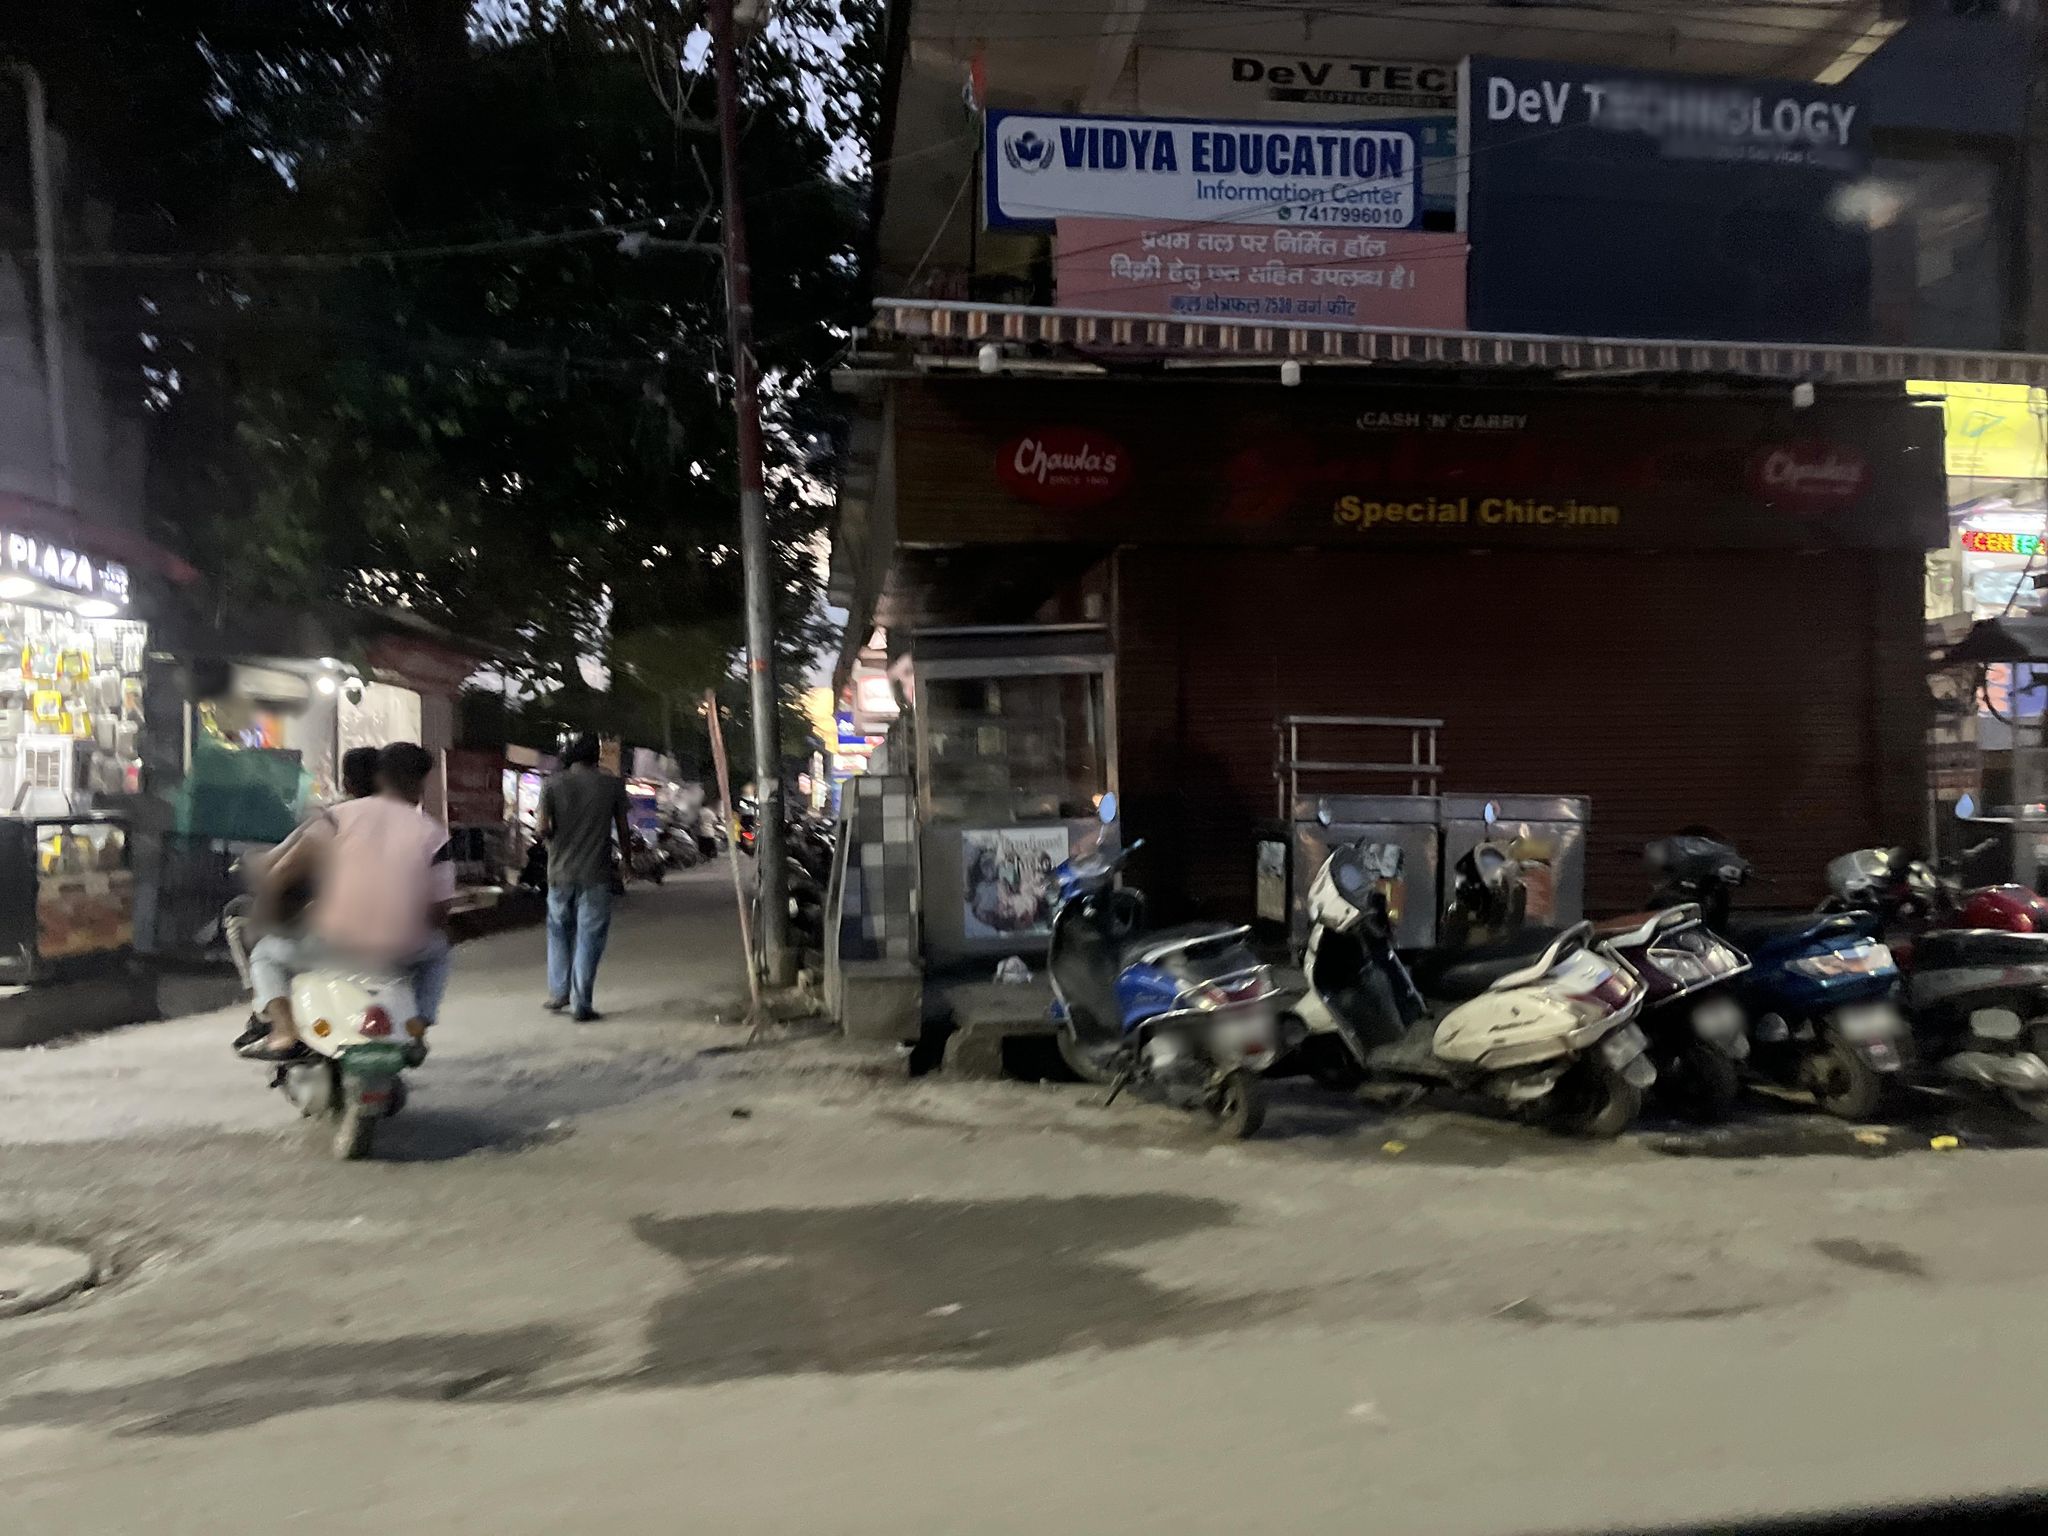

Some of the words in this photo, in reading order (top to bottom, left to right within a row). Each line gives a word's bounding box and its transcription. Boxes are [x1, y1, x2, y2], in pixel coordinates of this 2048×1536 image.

[1232, 57, 1333, 87] DeV
[1350, 64, 1457, 93] TEC
[1487, 76, 1570, 124] DeV
[1060, 125, 1178, 172] VIDYA
[1192, 131, 1403, 179] EDUCATION
[1197, 178, 1325, 202] Information
[1331, 183, 1402, 205] Center
[1298, 206, 1403, 224] 7417996010
[1141, 231, 1191, 252] प्रथम
[1197, 233, 1236, 253] तल
[1240, 235, 1270, 253] पर
[1273, 229, 1337, 255] निर्मित
[1247, 259, 1304, 286] सहित
[1358, 411, 1421, 429] CASH
[1457, 413, 1528, 431] CARRY
[1014, 437, 1118, 485] Chawla's
[1336, 495, 1469, 529] Special
[1479, 498, 1621, 525] Chic-inn
[9, 533, 94, 592] PLAZA
